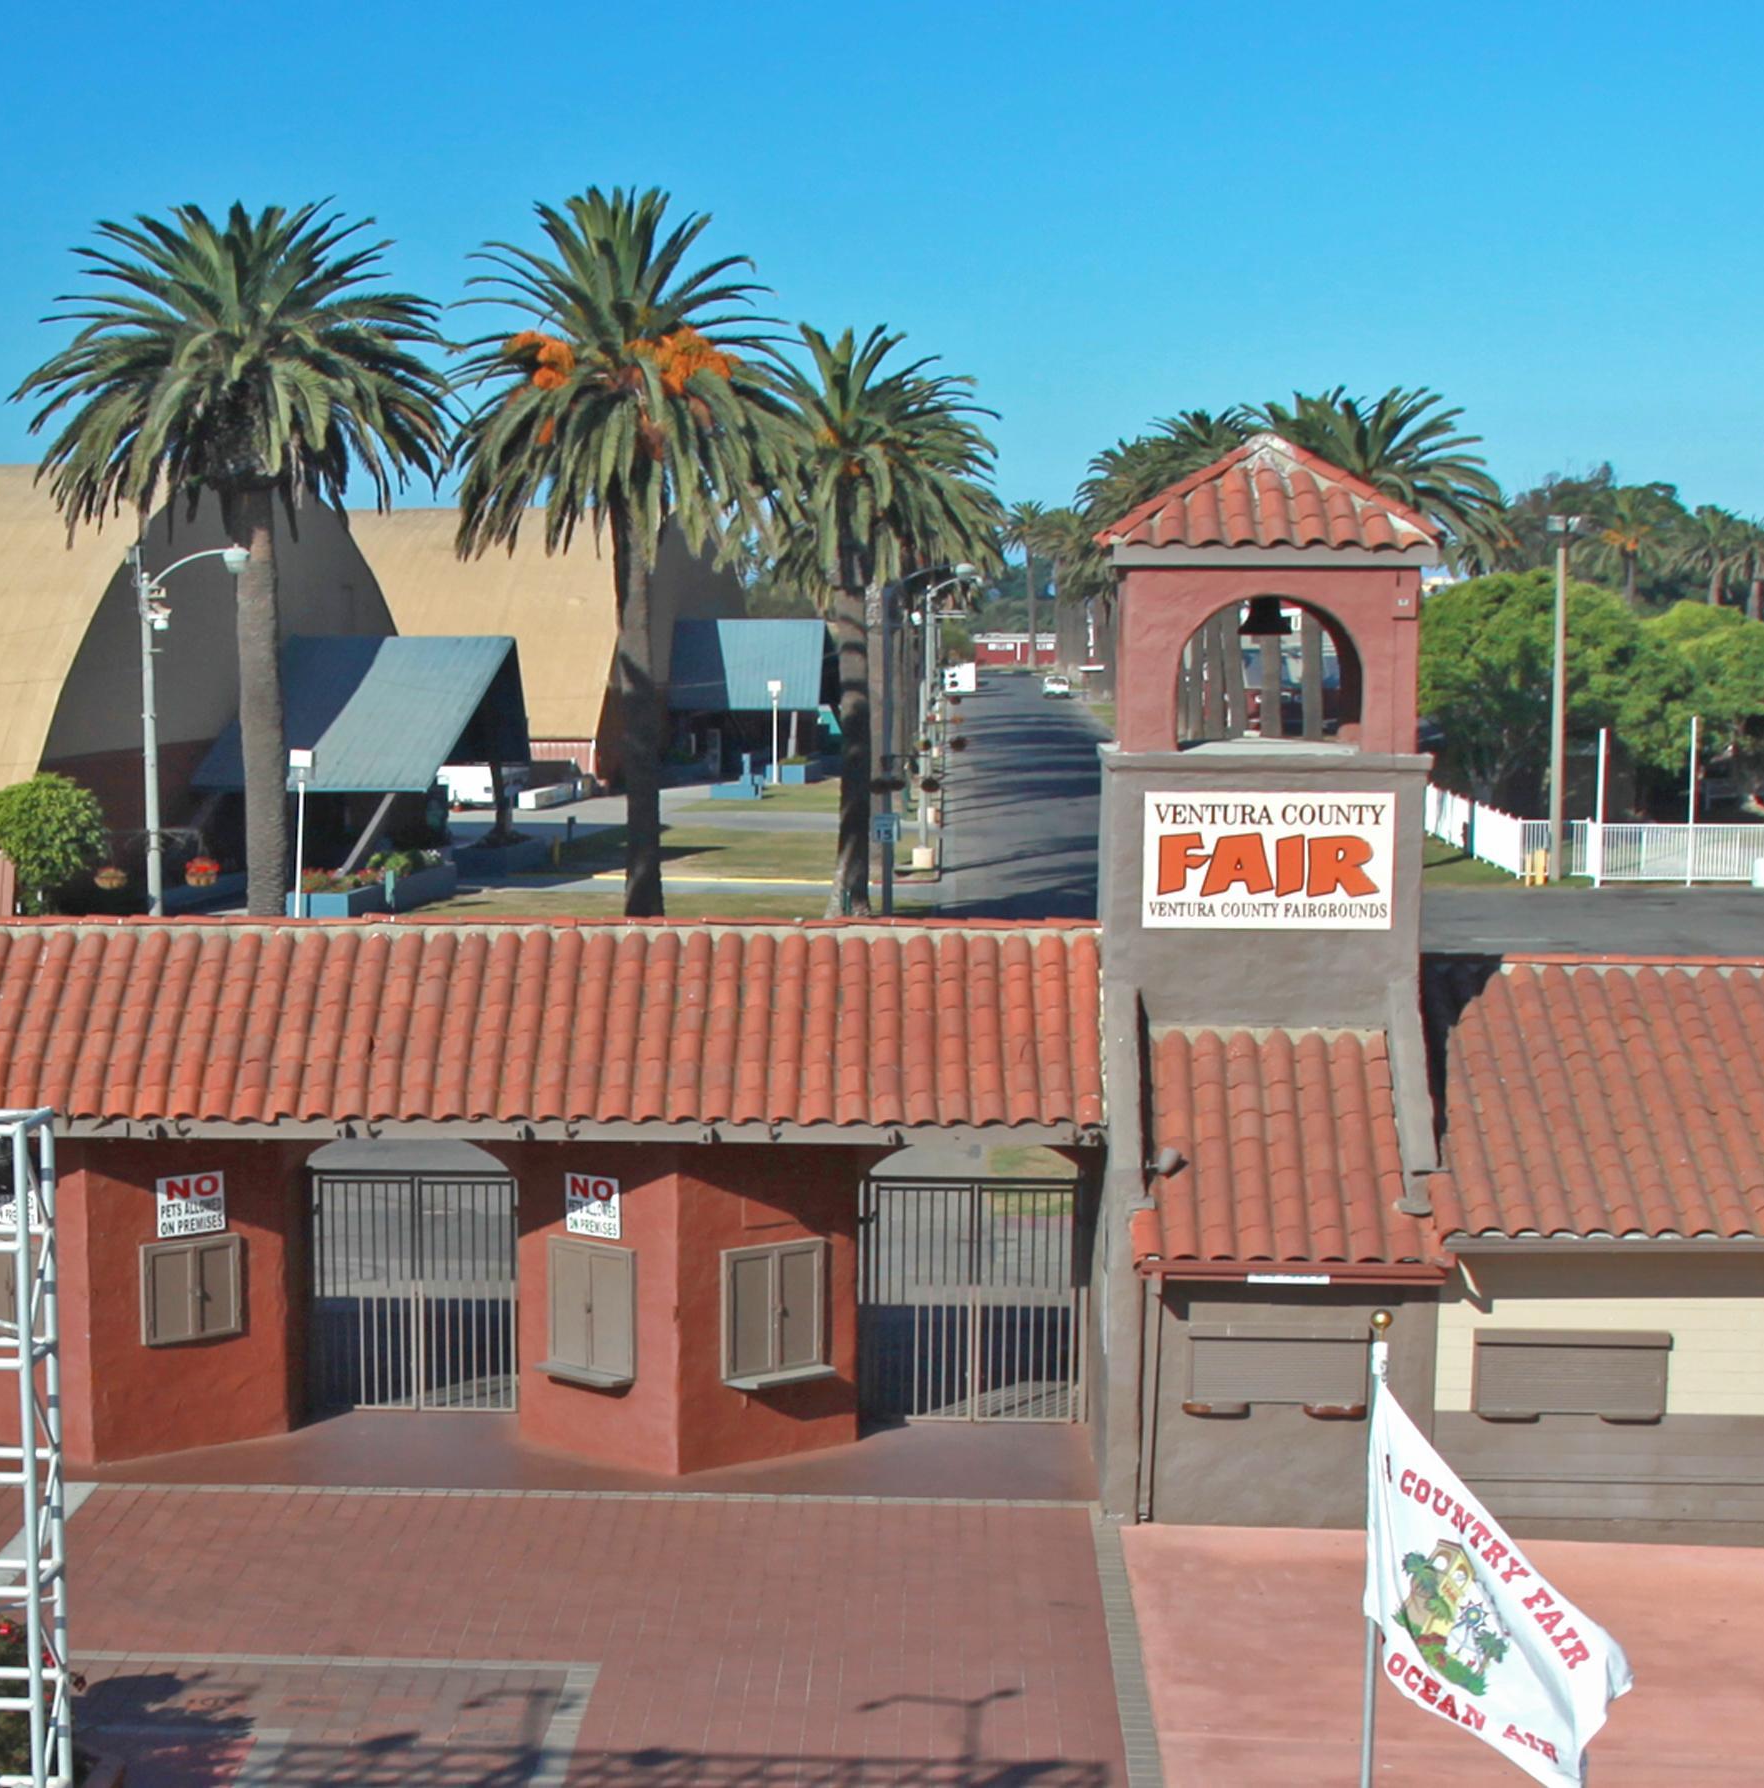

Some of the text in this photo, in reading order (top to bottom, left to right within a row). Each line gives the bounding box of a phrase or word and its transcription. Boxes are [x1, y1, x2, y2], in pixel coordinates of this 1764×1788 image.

[1155, 803, 1387, 825] VENTURA COUNTY
[877, 829, 894, 841] 15
[1156, 831, 1381, 898] FAIR
[1148, 902, 1388, 920] VENTURA COUNTY FAIRGROUNDS
[165, 1174, 219, 1201] NO
[570, 1175, 614, 1202] NO
[160, 1203, 182, 1219] PETS
[160, 1213, 224, 1236] ON PREMISES
[1399, 1468, 1591, 1672] COUNTRY FAIR
[1386, 1651, 1560, 1765] OCEAN AIR
